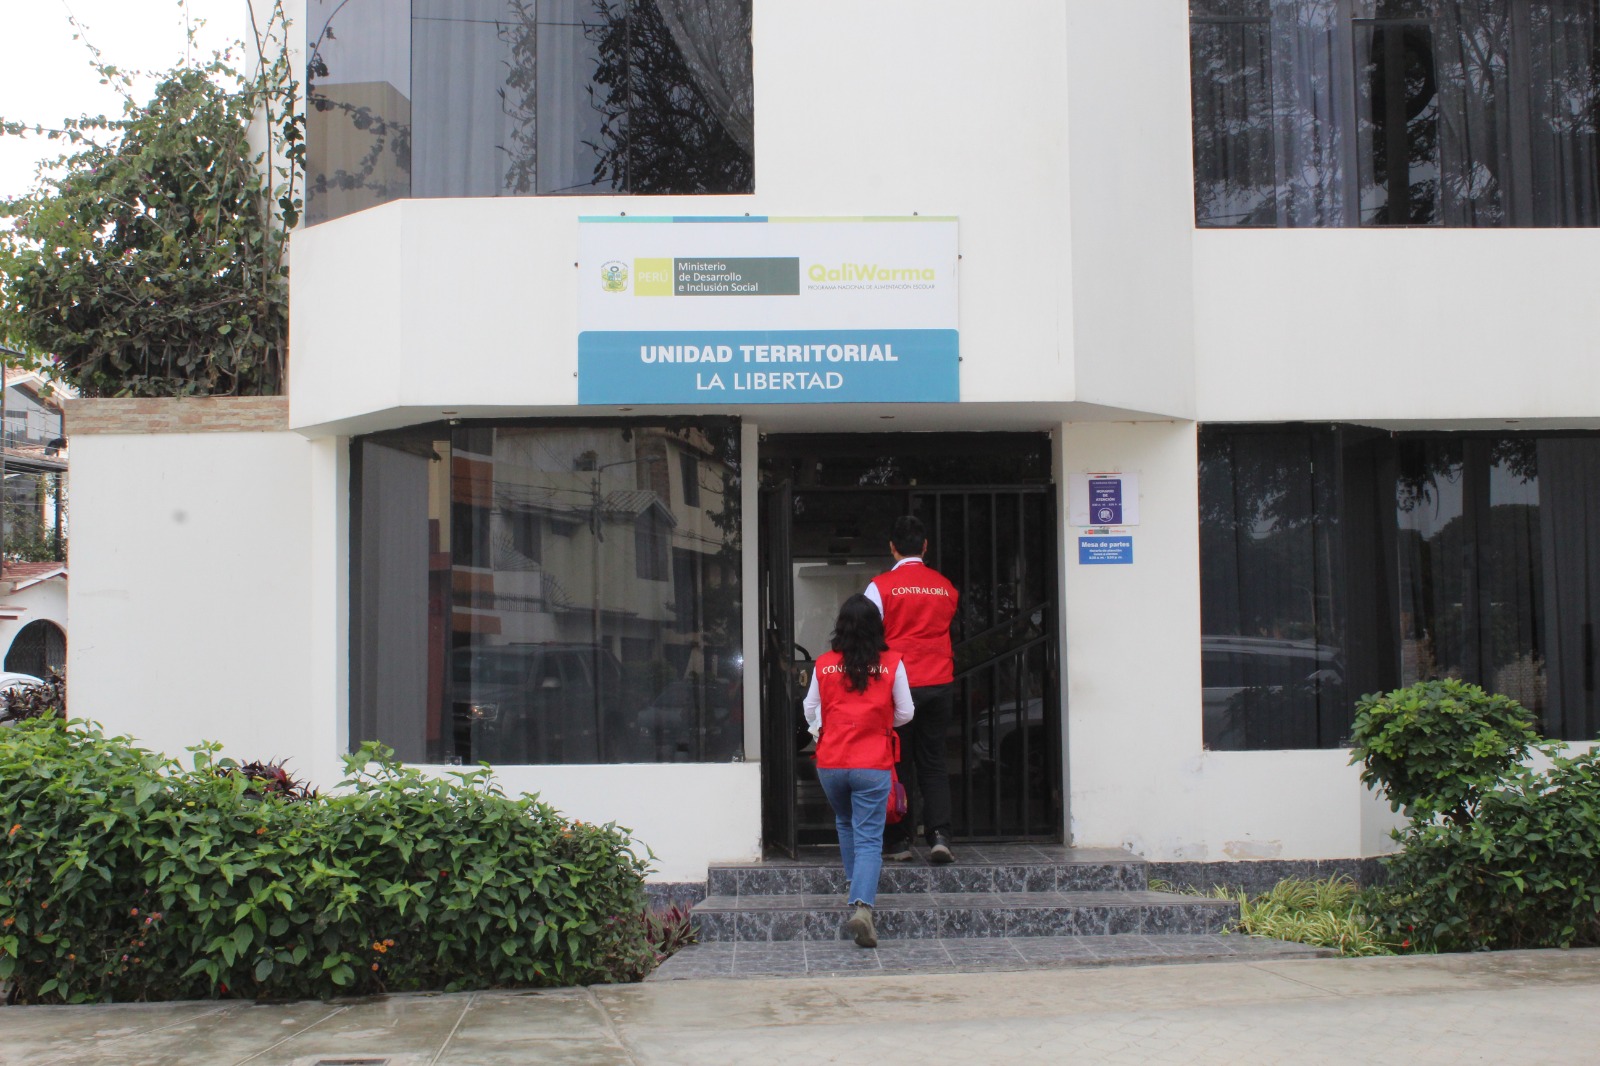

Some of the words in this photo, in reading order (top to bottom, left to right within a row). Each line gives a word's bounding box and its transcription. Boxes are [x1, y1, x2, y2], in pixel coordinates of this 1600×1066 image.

[678, 262, 727, 271] Ministerio
[638, 269, 669, 283] PERÚ
[678, 272, 691, 282] de
[693, 272, 742, 282] Desarrollo
[808, 263, 936, 283] QaliWarma
[678, 284, 685, 292] e
[687, 282, 729, 292] Inclusión
[731, 282, 759, 292] Social
[640, 345, 733, 364] UNIDAD
[739, 344, 899, 363] TERRITORIAL
[696, 372, 726, 390] LA
[734, 371, 844, 390] LIBERTAD
[891, 586, 949, 597] CONTRALORÍA
